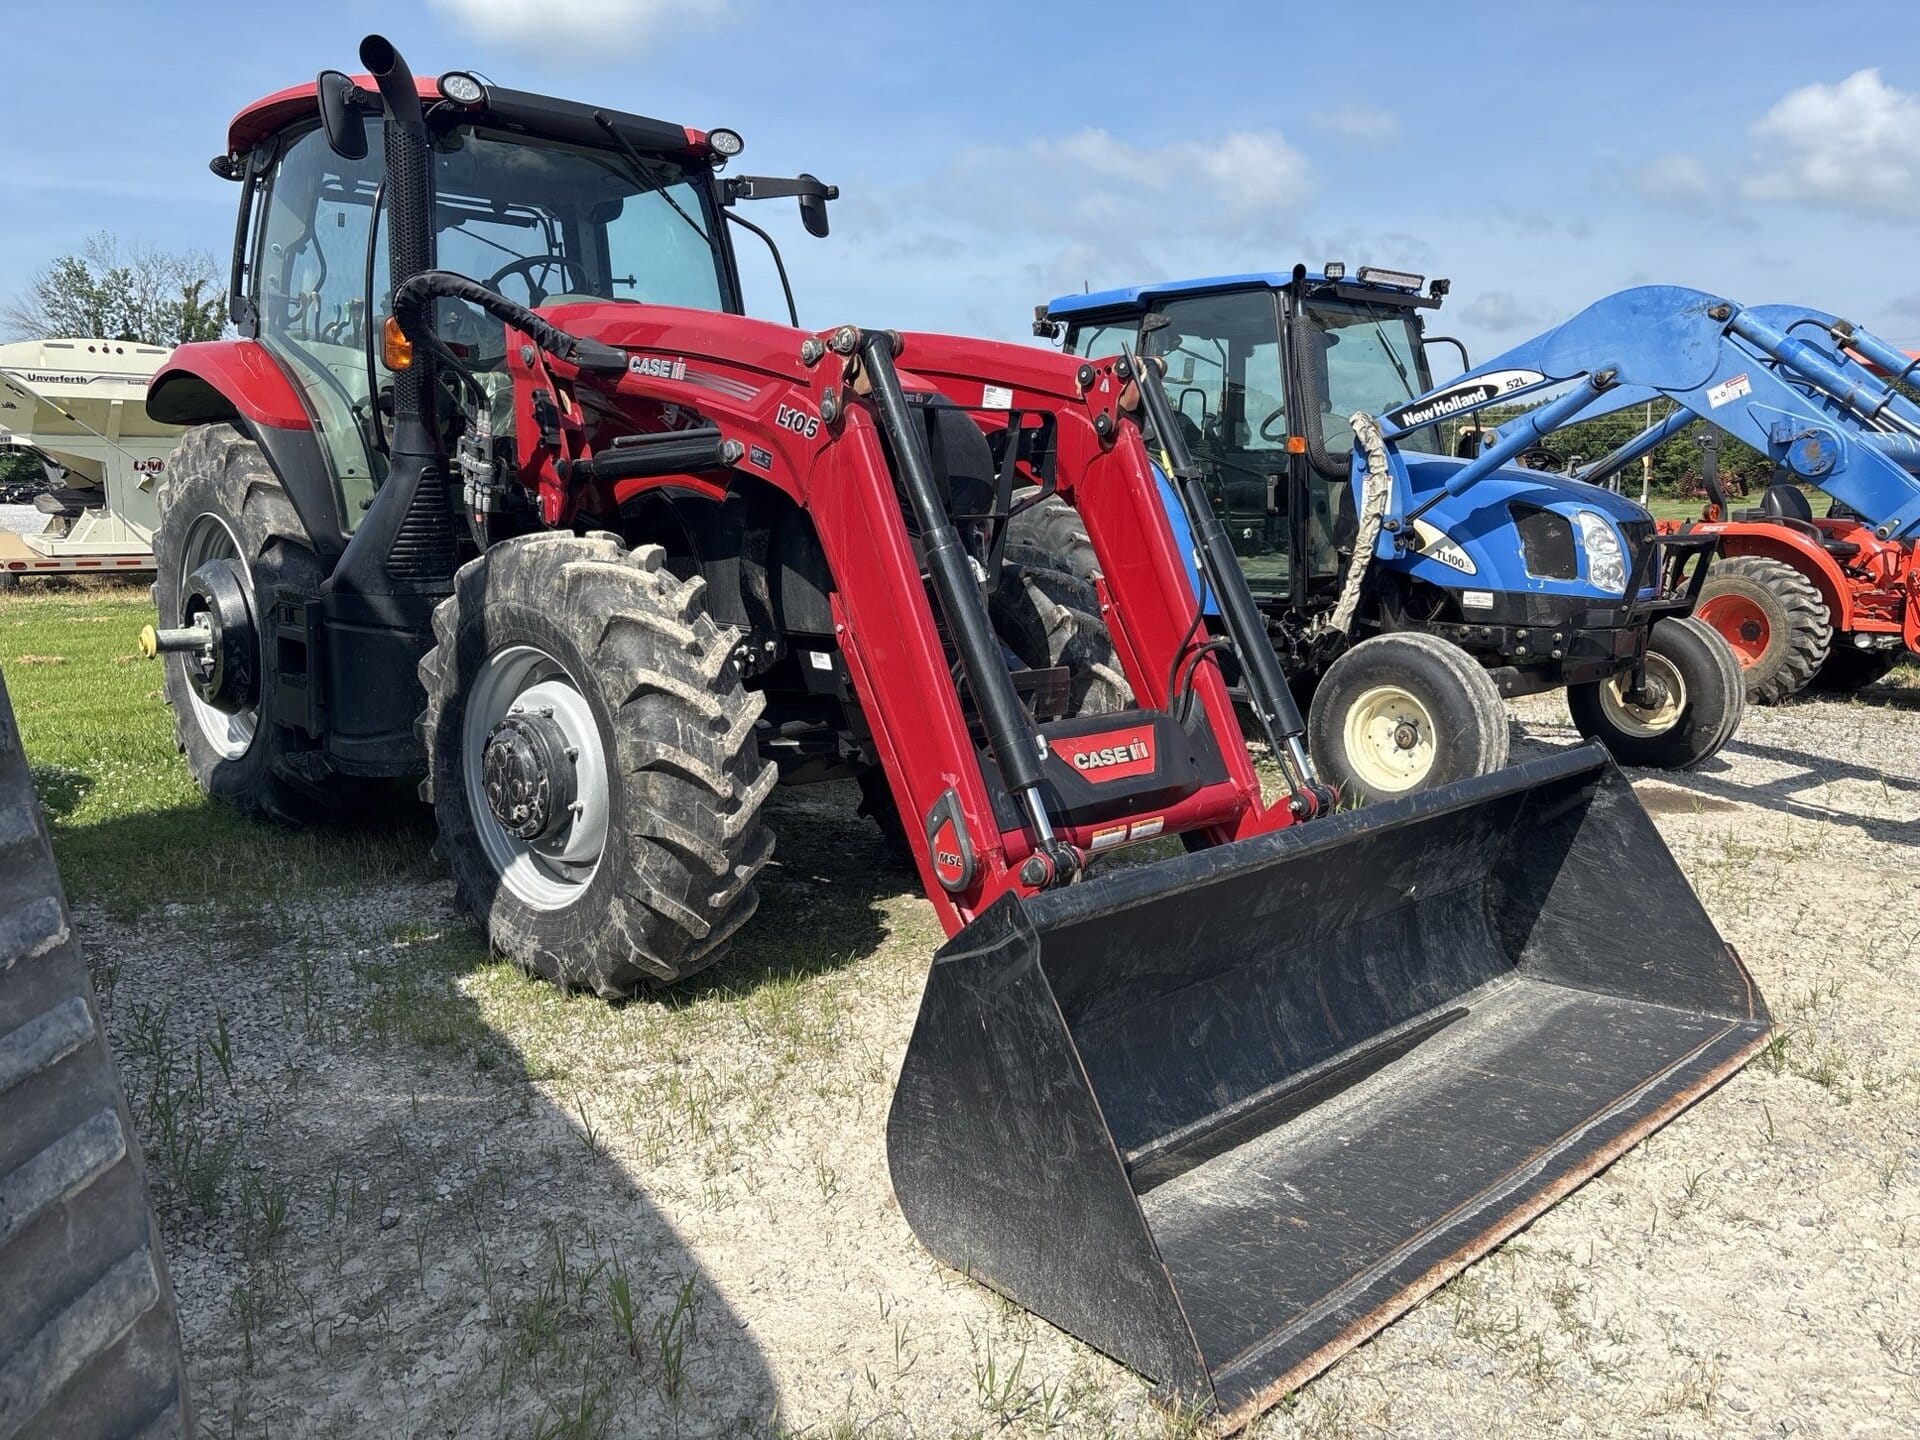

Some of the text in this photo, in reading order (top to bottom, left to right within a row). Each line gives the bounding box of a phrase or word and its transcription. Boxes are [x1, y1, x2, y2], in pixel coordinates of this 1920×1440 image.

[629, 355, 671, 379] CASE
[27, 373, 88, 384] Unverferth
[1505, 376, 1529, 391] 52L
[775, 403, 820, 440] L105
[1073, 747, 1130, 770] CASE
[938, 851, 963, 868] MSL
